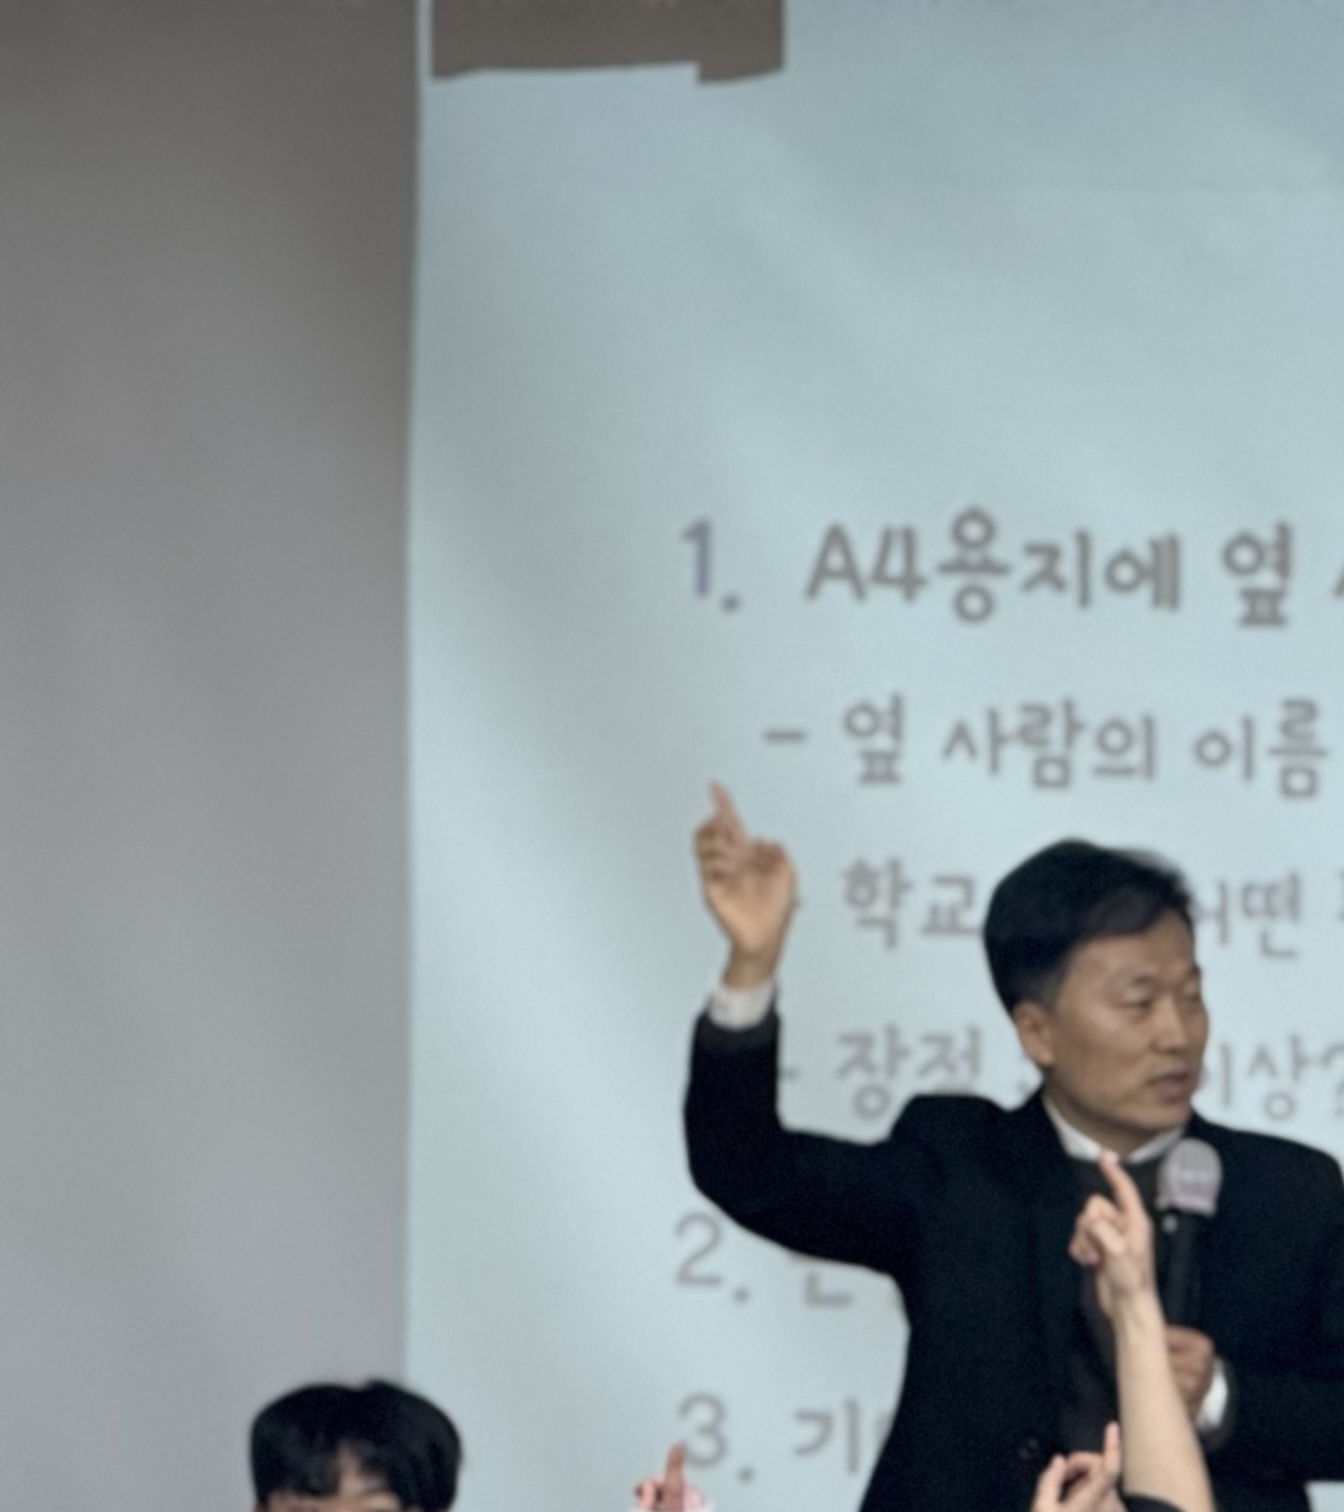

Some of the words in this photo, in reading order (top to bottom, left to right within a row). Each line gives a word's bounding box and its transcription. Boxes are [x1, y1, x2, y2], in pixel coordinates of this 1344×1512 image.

[680, 515, 742, 614] 1.
[802, 502, 1184, 627] A4용지에
[1219, 517, 1296, 631] 옆
[840, 691, 907, 788] 옆
[940, 694, 1160, 793] 사람의
[1190, 695, 1330, 802] 이름
[673, 1210, 751, 1306] 2.
[678, 1394, 757, 1484] 3.
